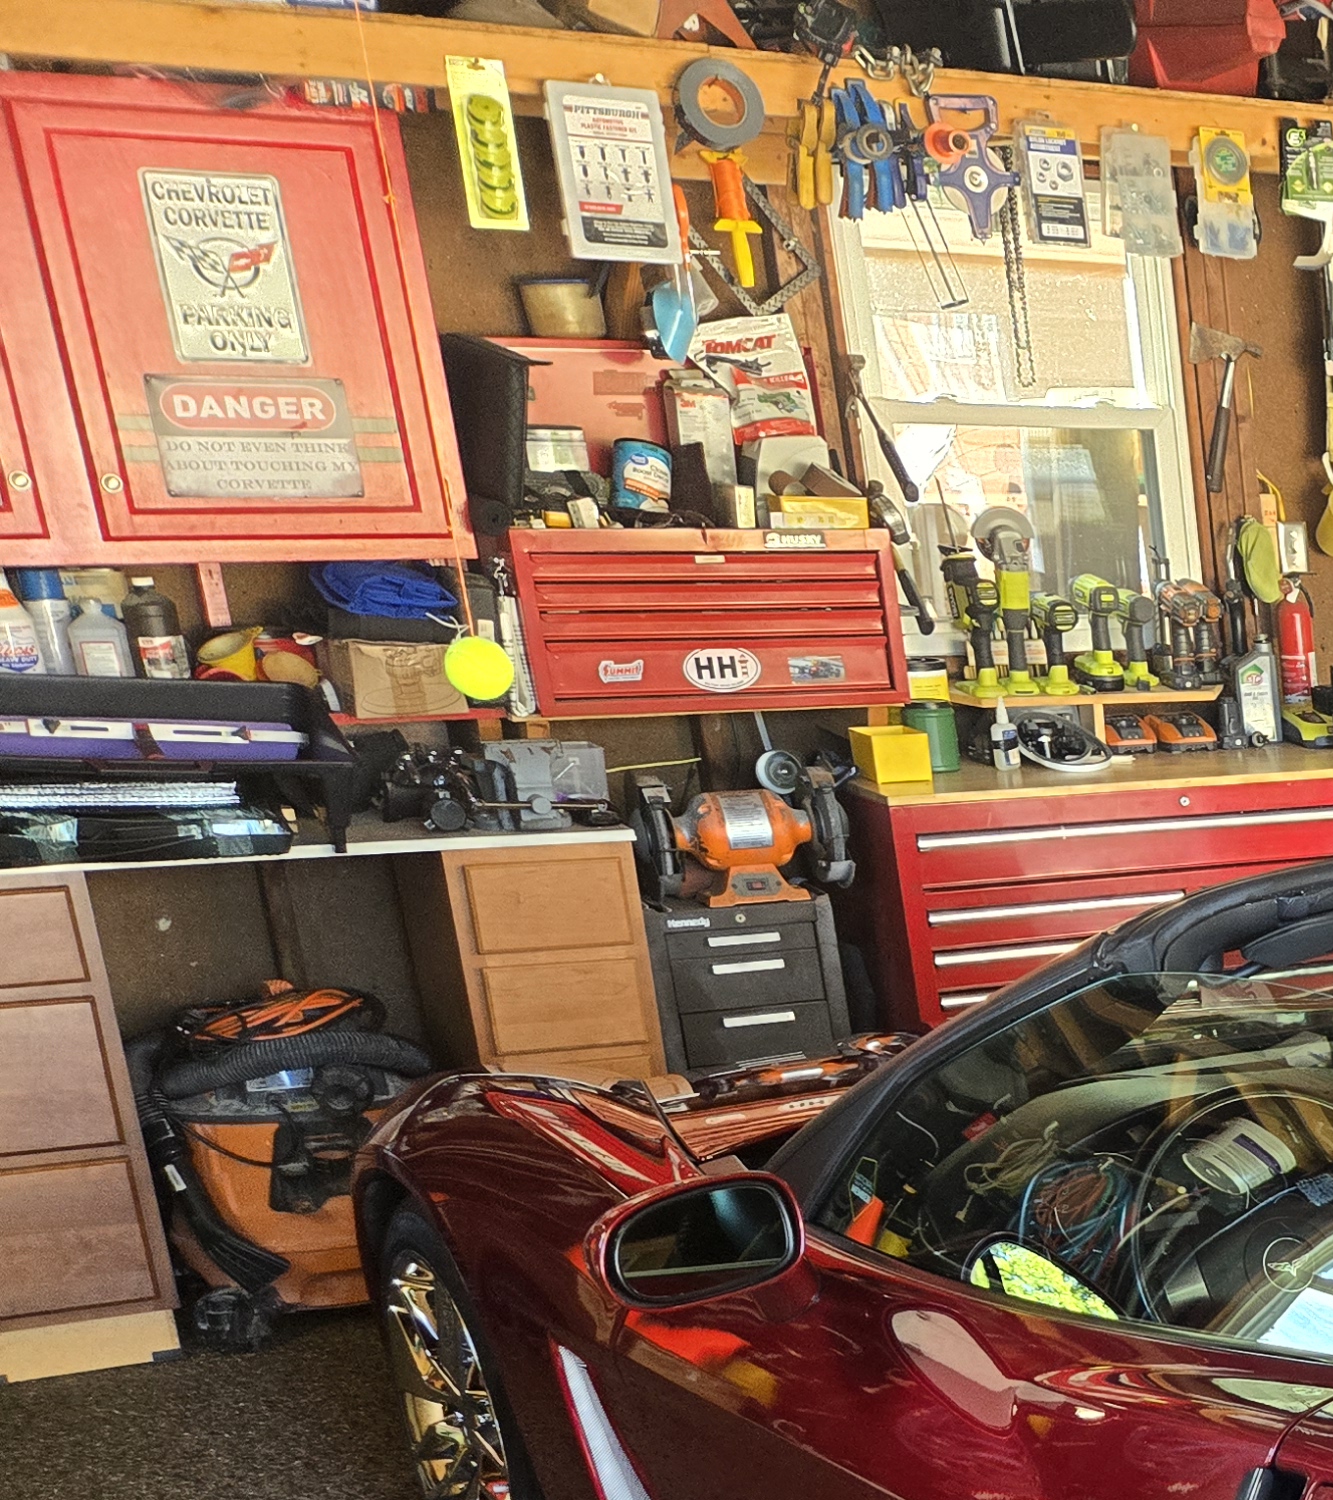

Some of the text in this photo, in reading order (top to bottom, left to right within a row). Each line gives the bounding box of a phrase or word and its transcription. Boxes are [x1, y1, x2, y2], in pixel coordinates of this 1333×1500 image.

[573, 104, 641, 119] PITTSBURGH
[150, 180, 272, 206] CHEVROLET
[163, 206, 271, 231] CORVETTE
[178, 304, 294, 332] PARKING
[209, 330, 273, 354] ONLY
[704, 334, 777, 355] TOMCAT
[172, 394, 326, 421] DANGER
[680, 399, 696, 409] 3M
[166, 441, 349, 454] DO NOT EVEN THINK
[166, 459, 358, 473] ABOUT TOUCHING MY
[216, 478, 312, 490] CORVETTE
[780, 534, 822, 545] HUSKY
[602, 662, 642, 676] SUMMIT
[694, 655, 738, 680] HH
[667, 917, 711, 928] Kennedy
